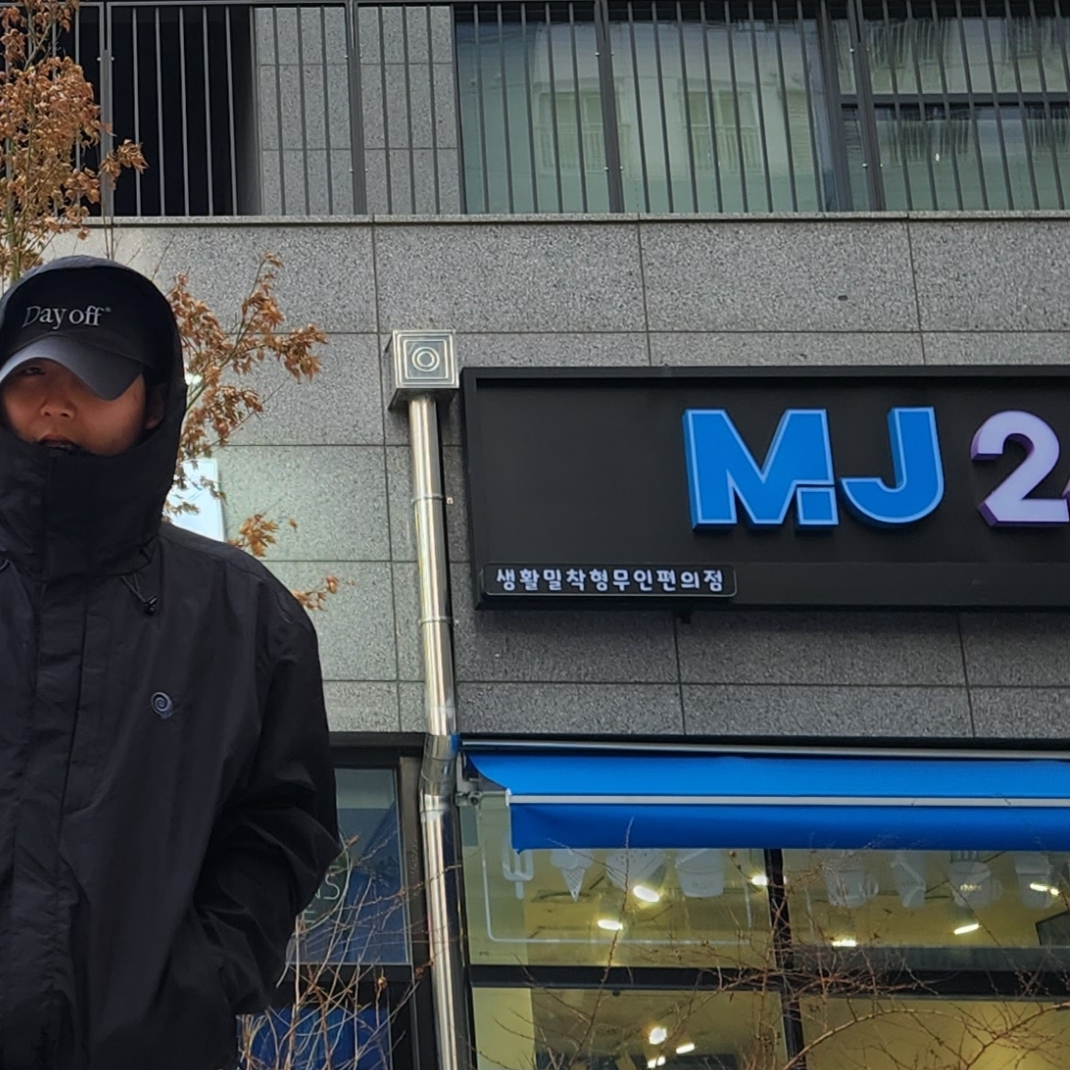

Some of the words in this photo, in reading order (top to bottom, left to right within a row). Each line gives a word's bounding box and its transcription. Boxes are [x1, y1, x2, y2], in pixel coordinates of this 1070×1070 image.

[22, 305, 67, 330] Day
[682, 406, 944, 530] MJ
[970, 409, 1070, 528] 2
[496, 568, 724, 592] 생활밀착형무인편의점
